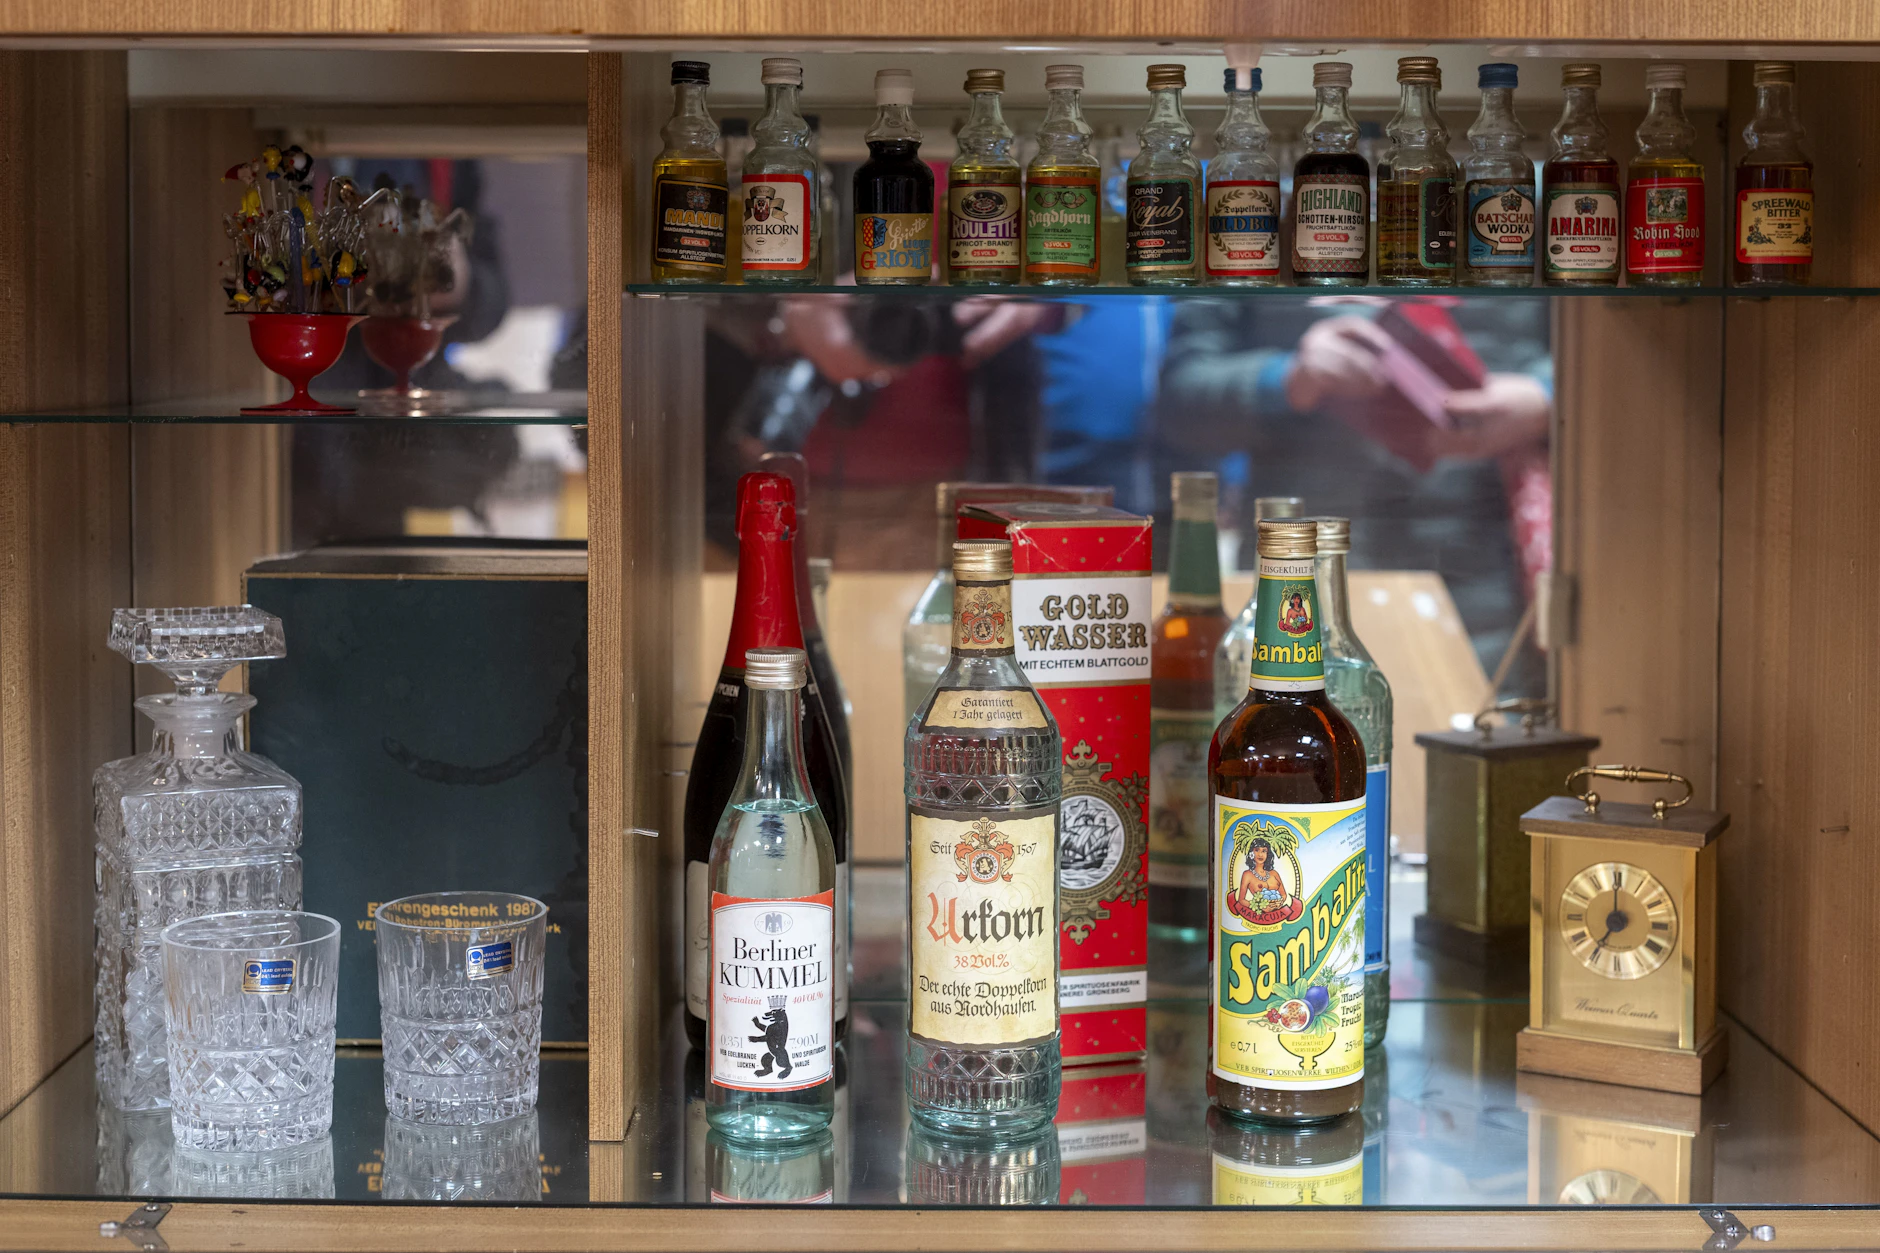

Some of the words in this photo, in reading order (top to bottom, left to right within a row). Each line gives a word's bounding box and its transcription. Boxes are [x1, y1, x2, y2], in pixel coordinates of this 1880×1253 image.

[1135, 187, 1163, 195] GRAND
[1301, 188, 1362, 213] HIGHLAND
[1751, 198, 1811, 212] SPREEWALD
[1028, 209, 1091, 228] Jagdhorn
[1129, 195, 1184, 230] Royal
[1298, 214, 1365, 225] SCHOTTEN-KIRSCH
[1767, 209, 1801, 218] BITTER
[952, 213, 1018, 239] ROULETTE
[1488, 224, 1531, 235] WODKA
[1550, 217, 1617, 237] AMARINA
[1633, 226, 1670, 241] Robin
[1673, 224, 1701, 240] Hood
[1263, 565, 1307, 575] EISGEKÜHLT
[1039, 593, 1129, 621] GOLD
[1018, 622, 1148, 652] WASSER
[1019, 661, 1038, 669] MIT
[1041, 659, 1085, 669] ECHTEM
[1087, 656, 1149, 667] BLATTGOLD
[961, 697, 1014, 708] Garantiert
[960, 709, 983, 720] Jahr
[986, 710, 1022, 721] gelagert
[930, 841, 952, 855] Seit
[1017, 842, 1037, 857] 1507
[506, 902, 536, 917] 1987
[1239, 907, 1287, 922] MARACUJA
[926, 891, 1045, 947] Urkorn
[733, 937, 817, 961] Berliner
[953, 956, 969, 968] 38
[719, 961, 828, 989] KÜMMEL
[919, 975, 940, 993] Der
[942, 982, 971, 1000] echte
[974, 977, 1047, 1001] Doppelkorn
[1069, 980, 1140, 990] SPIRITUOSENFABRIK
[722, 992, 762, 1005] Spezialität
[930, 1003, 952, 1015] aus
[1341, 1014, 1362, 1028] Frucht
[1238, 1041, 1251, 1053] 0,7
[1235, 1063, 1249, 1071] VEB
